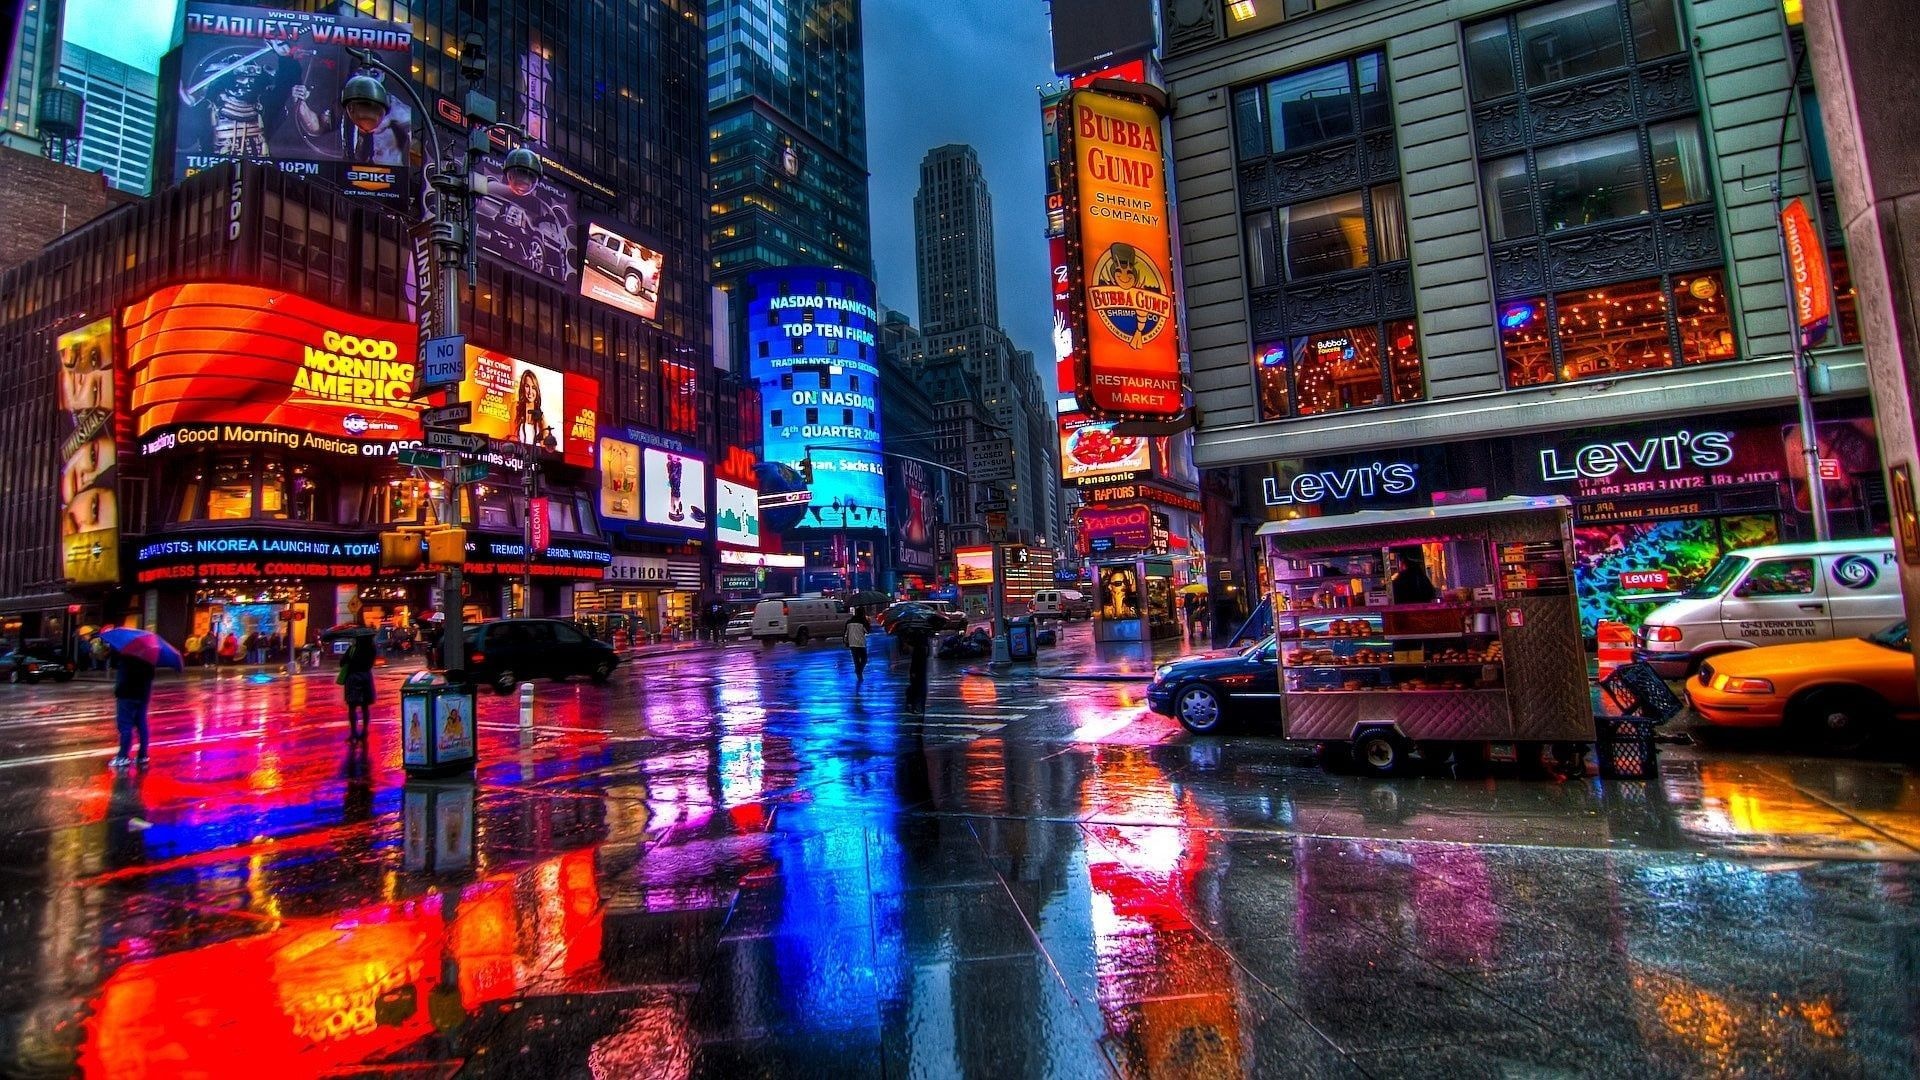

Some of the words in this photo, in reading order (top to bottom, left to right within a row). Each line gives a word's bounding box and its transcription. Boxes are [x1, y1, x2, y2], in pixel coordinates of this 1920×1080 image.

[268, 11, 295, 20] WHO
[312, 15, 335, 24] THE
[187, 12, 302, 40] DEADLIEST
[311, 23, 412, 51] WARRIOR
[1078, 104, 1158, 153] BUBBA
[279, 161, 320, 175] 10PM
[1088, 147, 1154, 189] GUMP
[347, 171, 396, 184] SPIKE
[1096, 192, 1152, 210] SHRIMP
[1089, 205, 1159, 228] COMPANY
[415, 237, 432, 305] VENIT
[770, 296, 824, 310] NASDAQ
[825, 297, 867, 316] THANKS
[1092, 289, 1134, 308] BUBBA
[1136, 291, 1169, 314] GUMP
[1106, 310, 1136, 318] SHRIMP
[1147, 313, 1158, 322] CO
[782, 324, 813, 338] TOP
[815, 324, 844, 338] TEN
[846, 328, 875, 346] FIRMS
[323, 330, 398, 360] GOOD
[437, 344, 454, 358] NO
[304, 345, 415, 382] MORNING
[428, 360, 464, 377] TURNS
[1095, 374, 1178, 390] RESTAURANT
[792, 390, 818, 406] ON
[821, 391, 875, 413] NASDAQ
[1111, 391, 1165, 406] MARKET
[449, 408, 465, 418] WAY
[342, 417, 368, 432] abc
[780, 425, 798, 438] 4th
[801, 426, 862, 440] QUARTER
[178, 426, 218, 444] Good
[224, 426, 299, 448] Morning
[303, 432, 358, 455] America
[362, 444, 386, 456] on
[433, 434, 453, 444] ONE
[462, 438, 478, 448] WAY
[974, 450, 1004, 460] CLOSED
[724, 445, 756, 482] JVC
[840, 460, 869, 472] Sachs
[1078, 472, 1135, 486] Panasonic
[1094, 486, 1135, 501] RAPTORS
[532, 502, 542, 550] WELCOME
[1084, 510, 1146, 530] YAHOO!
[197, 540, 258, 552] NKOREA
[262, 540, 312, 553] LAUNCH
[313, 543, 330, 554] NOT
[332, 544, 341, 555] A
[490, 544, 524, 555] TREMOR
[198, 562, 261, 576] STREAK,
[330, 564, 372, 578] TEXAS
[611, 566, 672, 580] SEPHORA
[1763, 620, 1794, 628] VERNON
[1740, 630, 1760, 638] LONG
[1760, 628, 1785, 637] ISLAND
